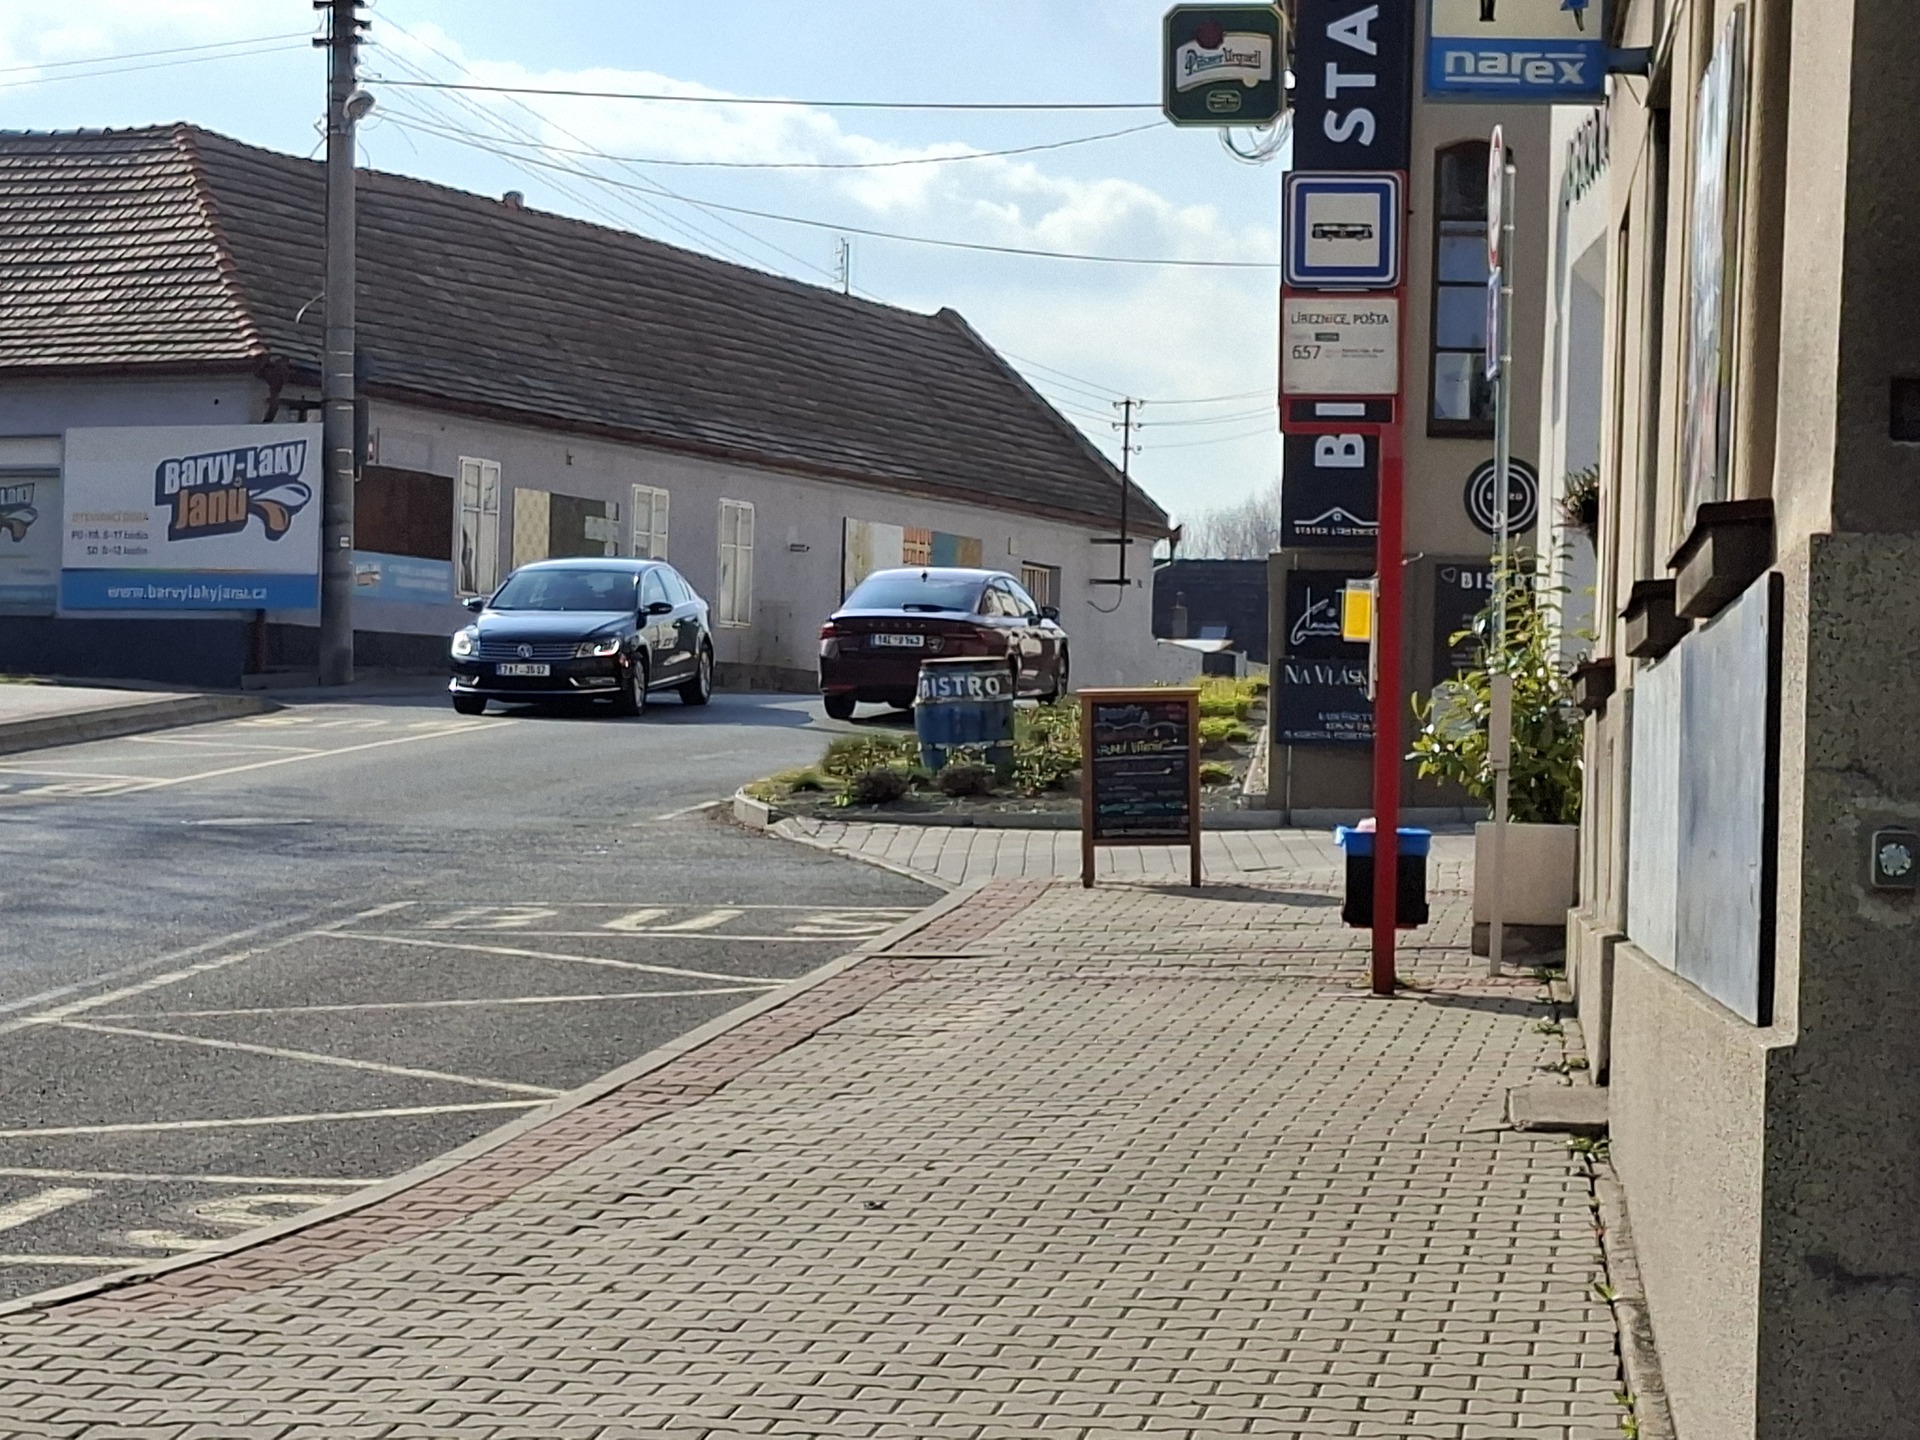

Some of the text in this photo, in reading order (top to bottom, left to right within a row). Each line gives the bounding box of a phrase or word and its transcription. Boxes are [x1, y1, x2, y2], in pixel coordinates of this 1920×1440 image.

[1445, 51, 1587, 84] narex
[1292, 345, 1321, 359] 657
[920, 675, 1001, 700] BISTRO
